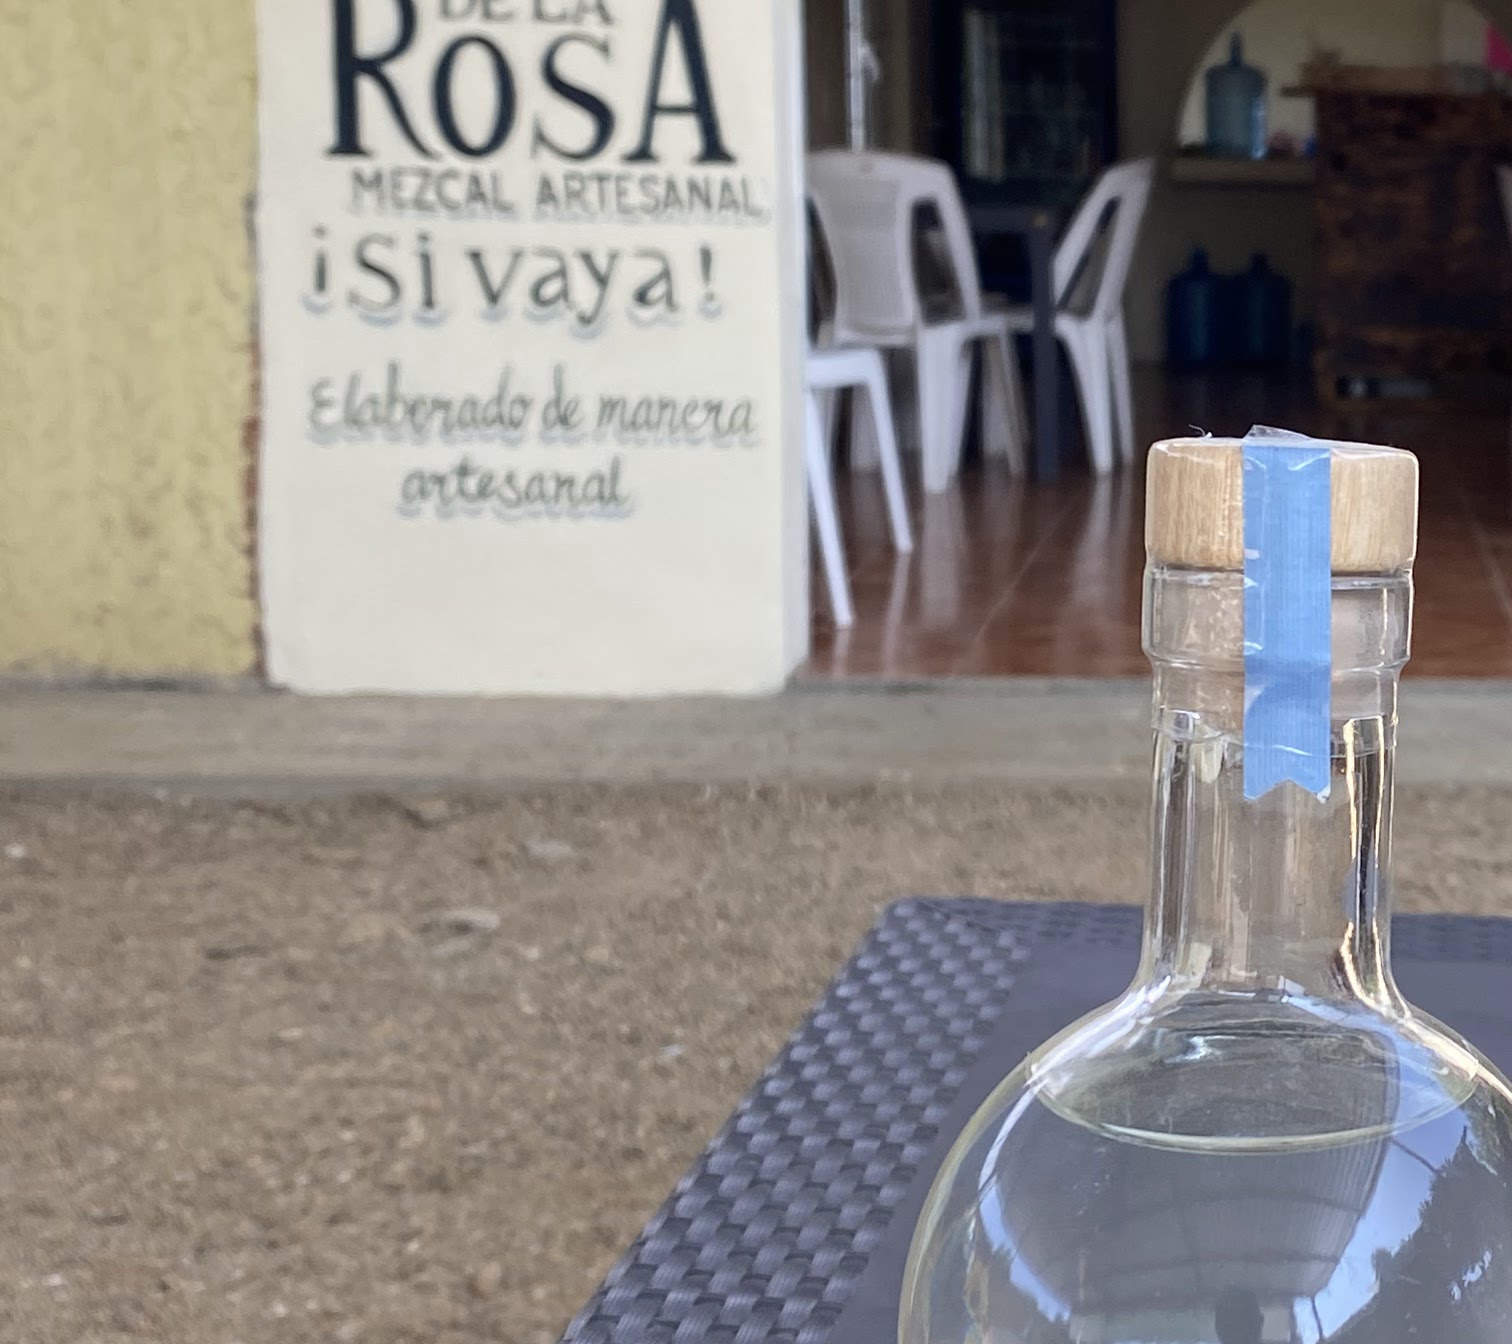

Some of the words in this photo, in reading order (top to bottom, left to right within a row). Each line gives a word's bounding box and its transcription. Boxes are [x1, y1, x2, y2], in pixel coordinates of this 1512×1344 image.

[350, 166, 514, 212] MEZCAL
[535, 170, 764, 218] ARTESANAL
[465, 242, 717, 326] vaya!
[309, 359, 532, 435] Elaborado
[542, 361, 583, 431] de
[597, 393, 755, 435] manera
[401, 455, 629, 509] artesanal
